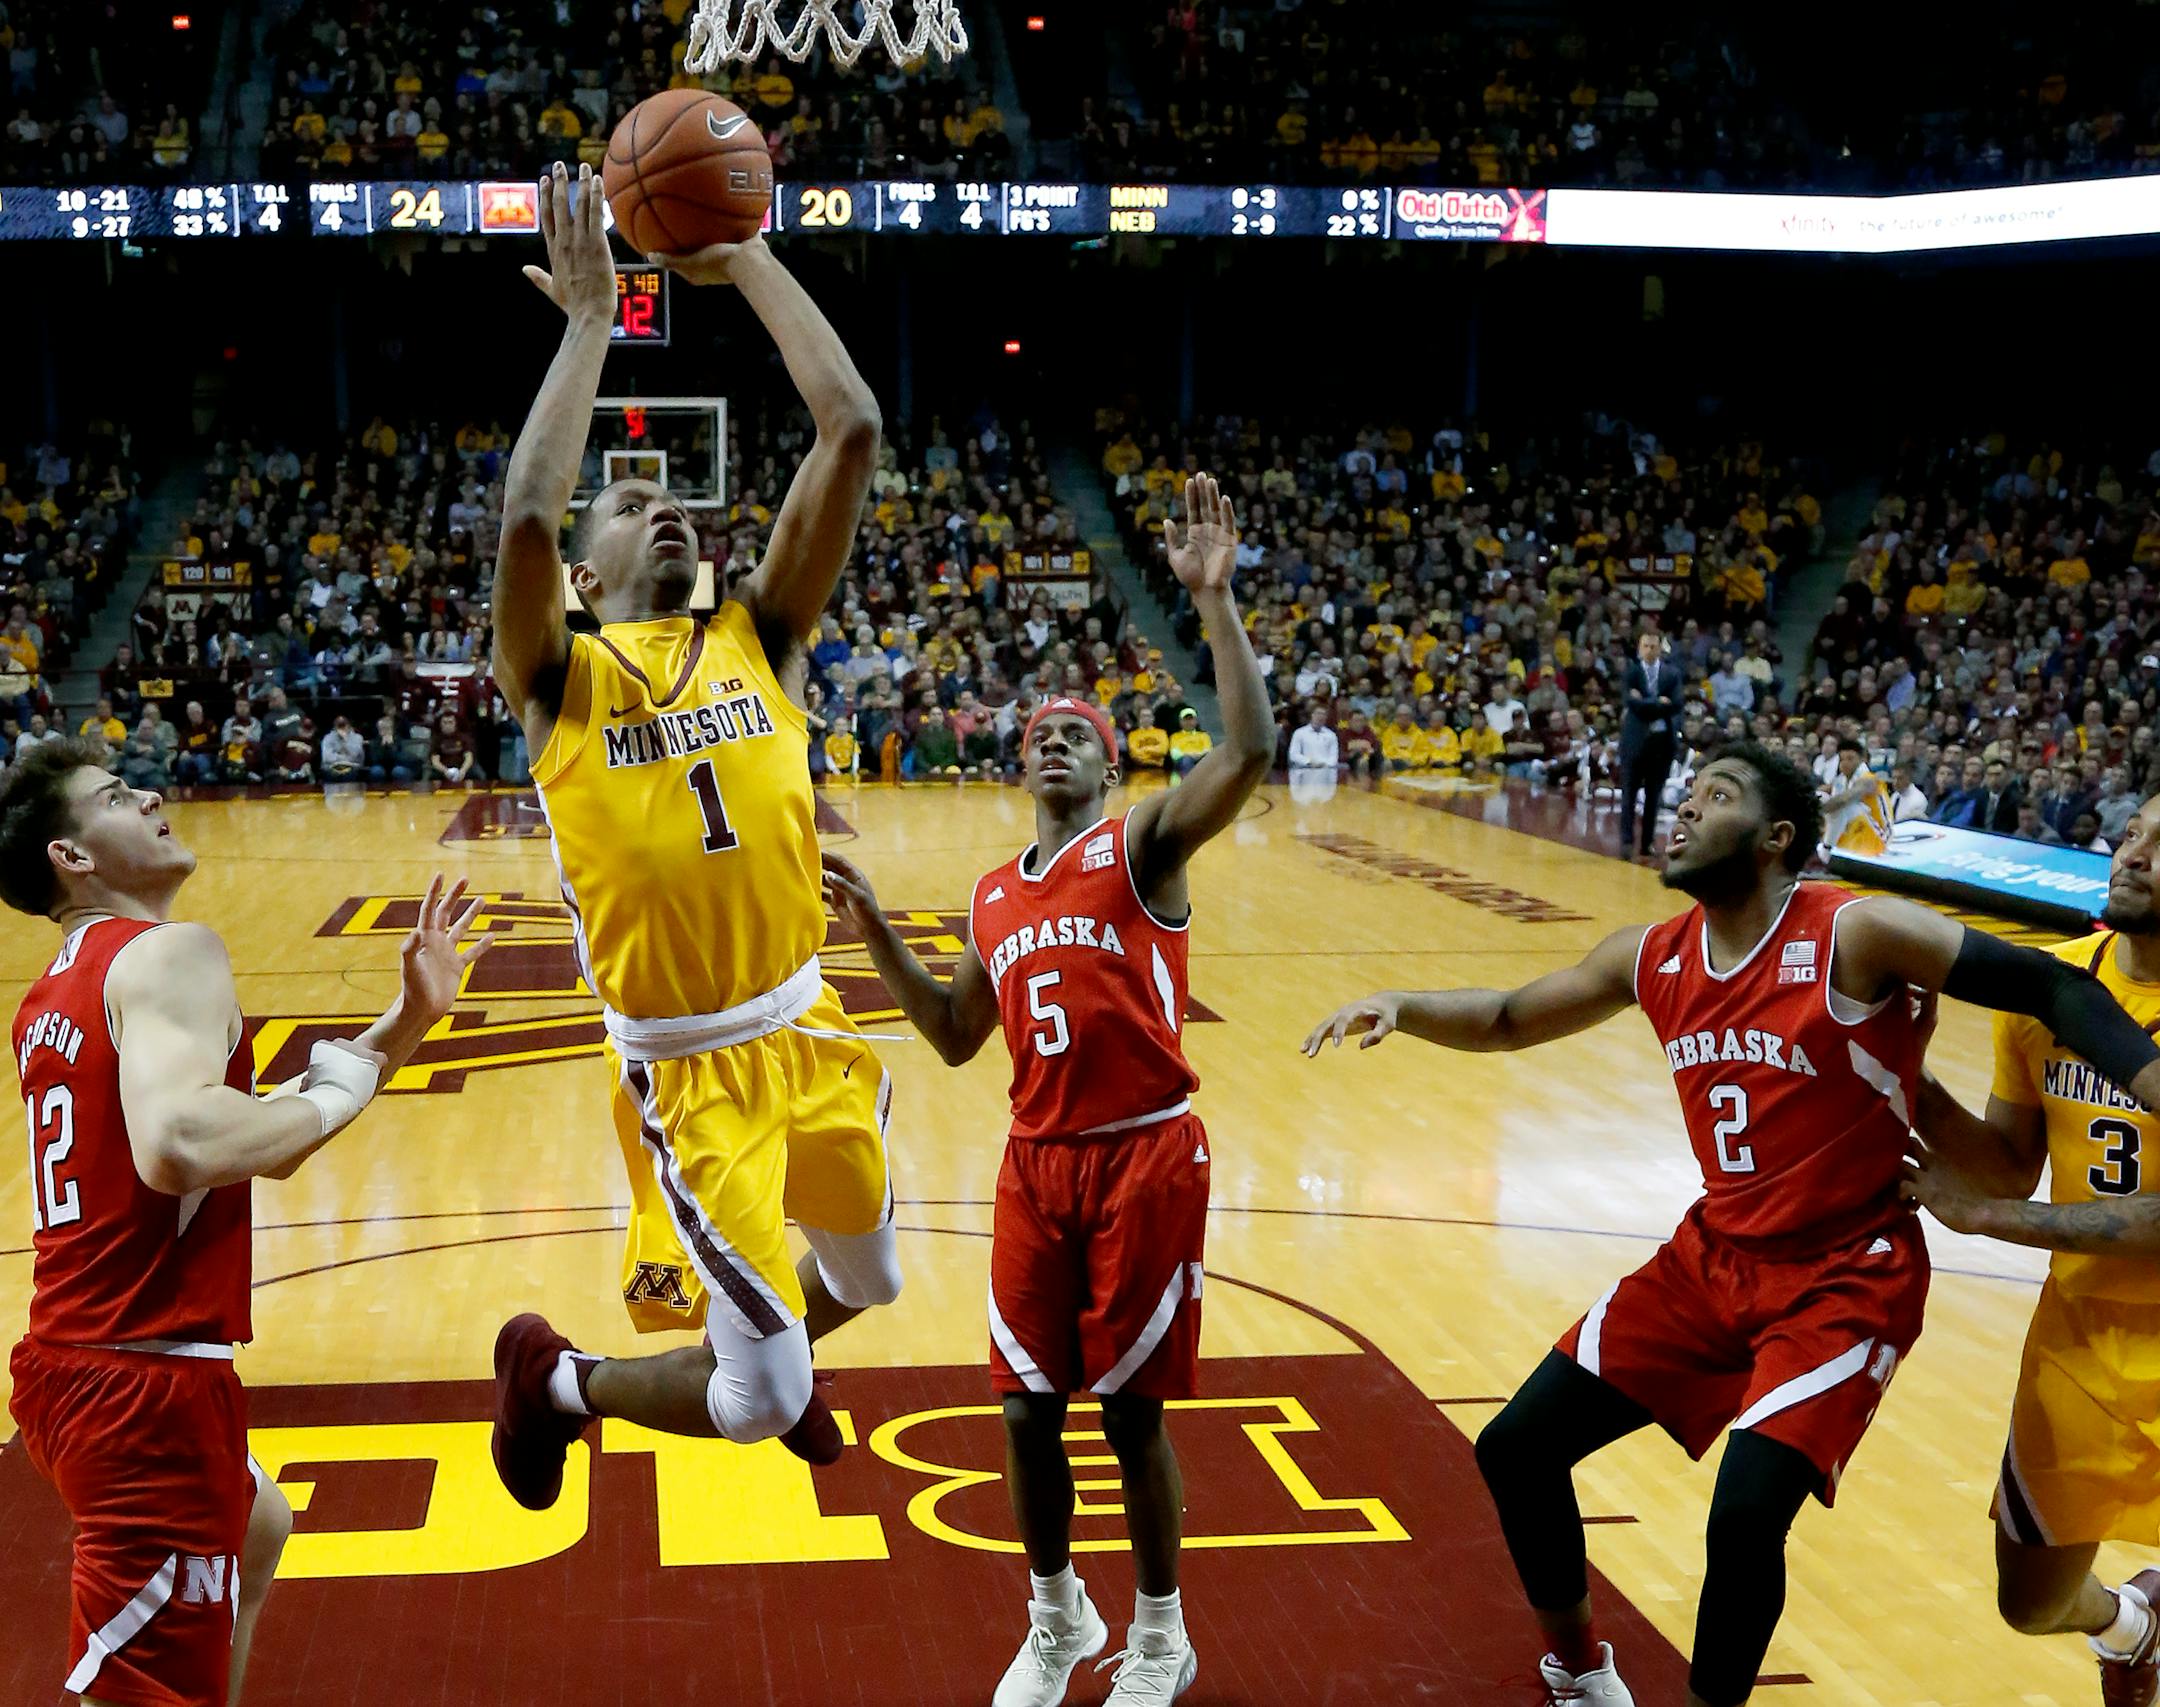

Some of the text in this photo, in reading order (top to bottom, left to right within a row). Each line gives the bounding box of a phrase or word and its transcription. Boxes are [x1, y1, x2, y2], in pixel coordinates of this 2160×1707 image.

[56, 189, 130, 212] 10-21
[390, 188, 445, 228] 24
[799, 187, 853, 227] 20
[898, 201, 921, 229] 4
[959, 201, 983, 229] 4
[1009, 184, 1079, 208] 3 POINT
[1110, 186, 1168, 208] MINN
[1231, 187, 1277, 209] 0-3
[1400, 192, 1505, 221] Old Dutch
[72, 216, 132, 238] 9-27
[258, 203, 282, 232] 4
[319, 202, 343, 231] 4
[1110, 211, 1156, 232] NEB
[1231, 213, 1277, 235] 2-9
[622, 294, 654, 334] 12
[602, 693, 775, 769] MINNESOTA
[686, 758, 740, 854] 1
[1027, 971, 1070, 1056] 5
[1708, 1084, 1756, 1173] 2
[27, 1084, 81, 1232] 12
[2087, 1116, 2142, 1197] 3
[624, 1261, 691, 1308] M
[182, 1556, 226, 1604] N
